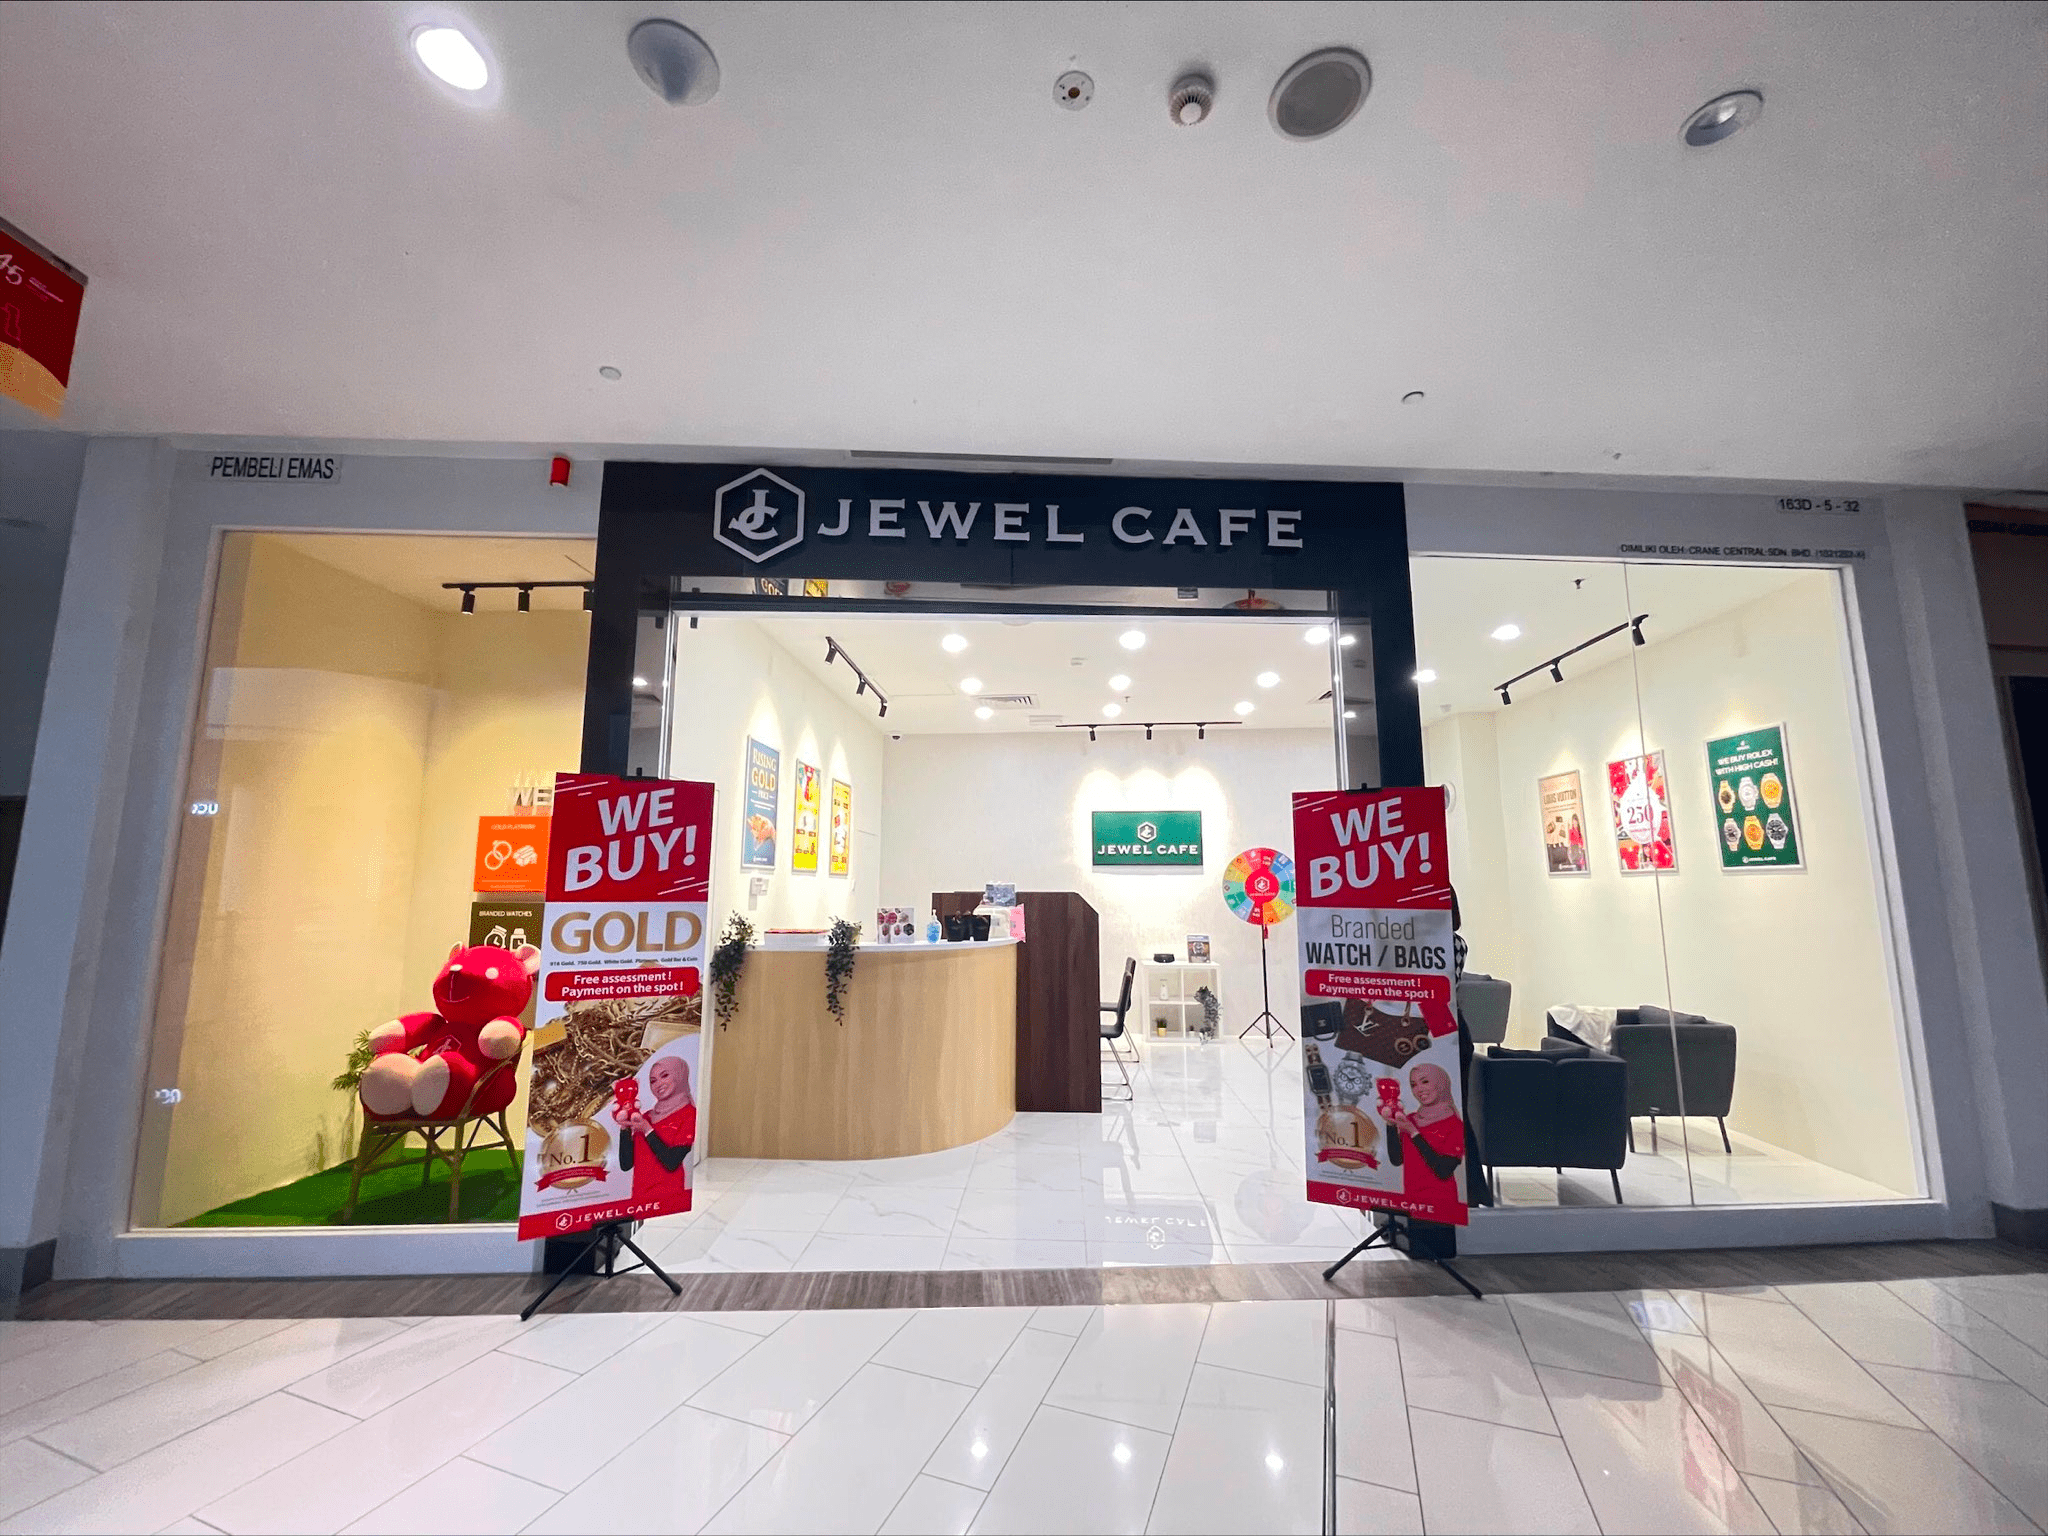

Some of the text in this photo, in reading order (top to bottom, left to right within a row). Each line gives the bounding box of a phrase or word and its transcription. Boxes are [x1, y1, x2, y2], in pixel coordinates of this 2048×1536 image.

[211, 456, 334, 479] PEMBELI EMAS
[1779, 498, 1812, 511] 163D
[1824, 499, 1833, 511] 5
[1842, 500, 1860, 512] 32
[817, 498, 1303, 548] JEWEL CAFE
[751, 767, 776, 792] GOLD
[598, 788, 675, 836] WE
[1330, 797, 1404, 847] WE
[564, 825, 697, 892] BUY!
[1097, 844, 1199, 855] JEWEL CAFE
[1309, 832, 1432, 899] BUY!
[550, 910, 703, 955] GOLD
[1331, 914, 1415, 941] Branded
[1306, 942, 1372, 967] WATCH
[1394, 945, 1447, 970] BAGS
[562, 985, 614, 998] Payment
[616, 985, 631, 995] on
[634, 982, 652, 994] the
[654, 983, 679, 995] spot
[574, 974, 600, 985] Free
[1319, 983, 1366, 996] Payment
[1367, 987, 1382, 995] on
[1384, 987, 1403, 997] the
[1404, 989, 1430, 1000] spot
[1328, 973, 1352, 984] Free
[1350, 1121, 1365, 1149] 1
[549, 1134, 593, 1167] No. 1
[575, 1208, 623, 1224] JEWEL
[626, 1201, 660, 1215] CAFE
[1353, 1194, 1435, 1214] JEWEL CAFE
